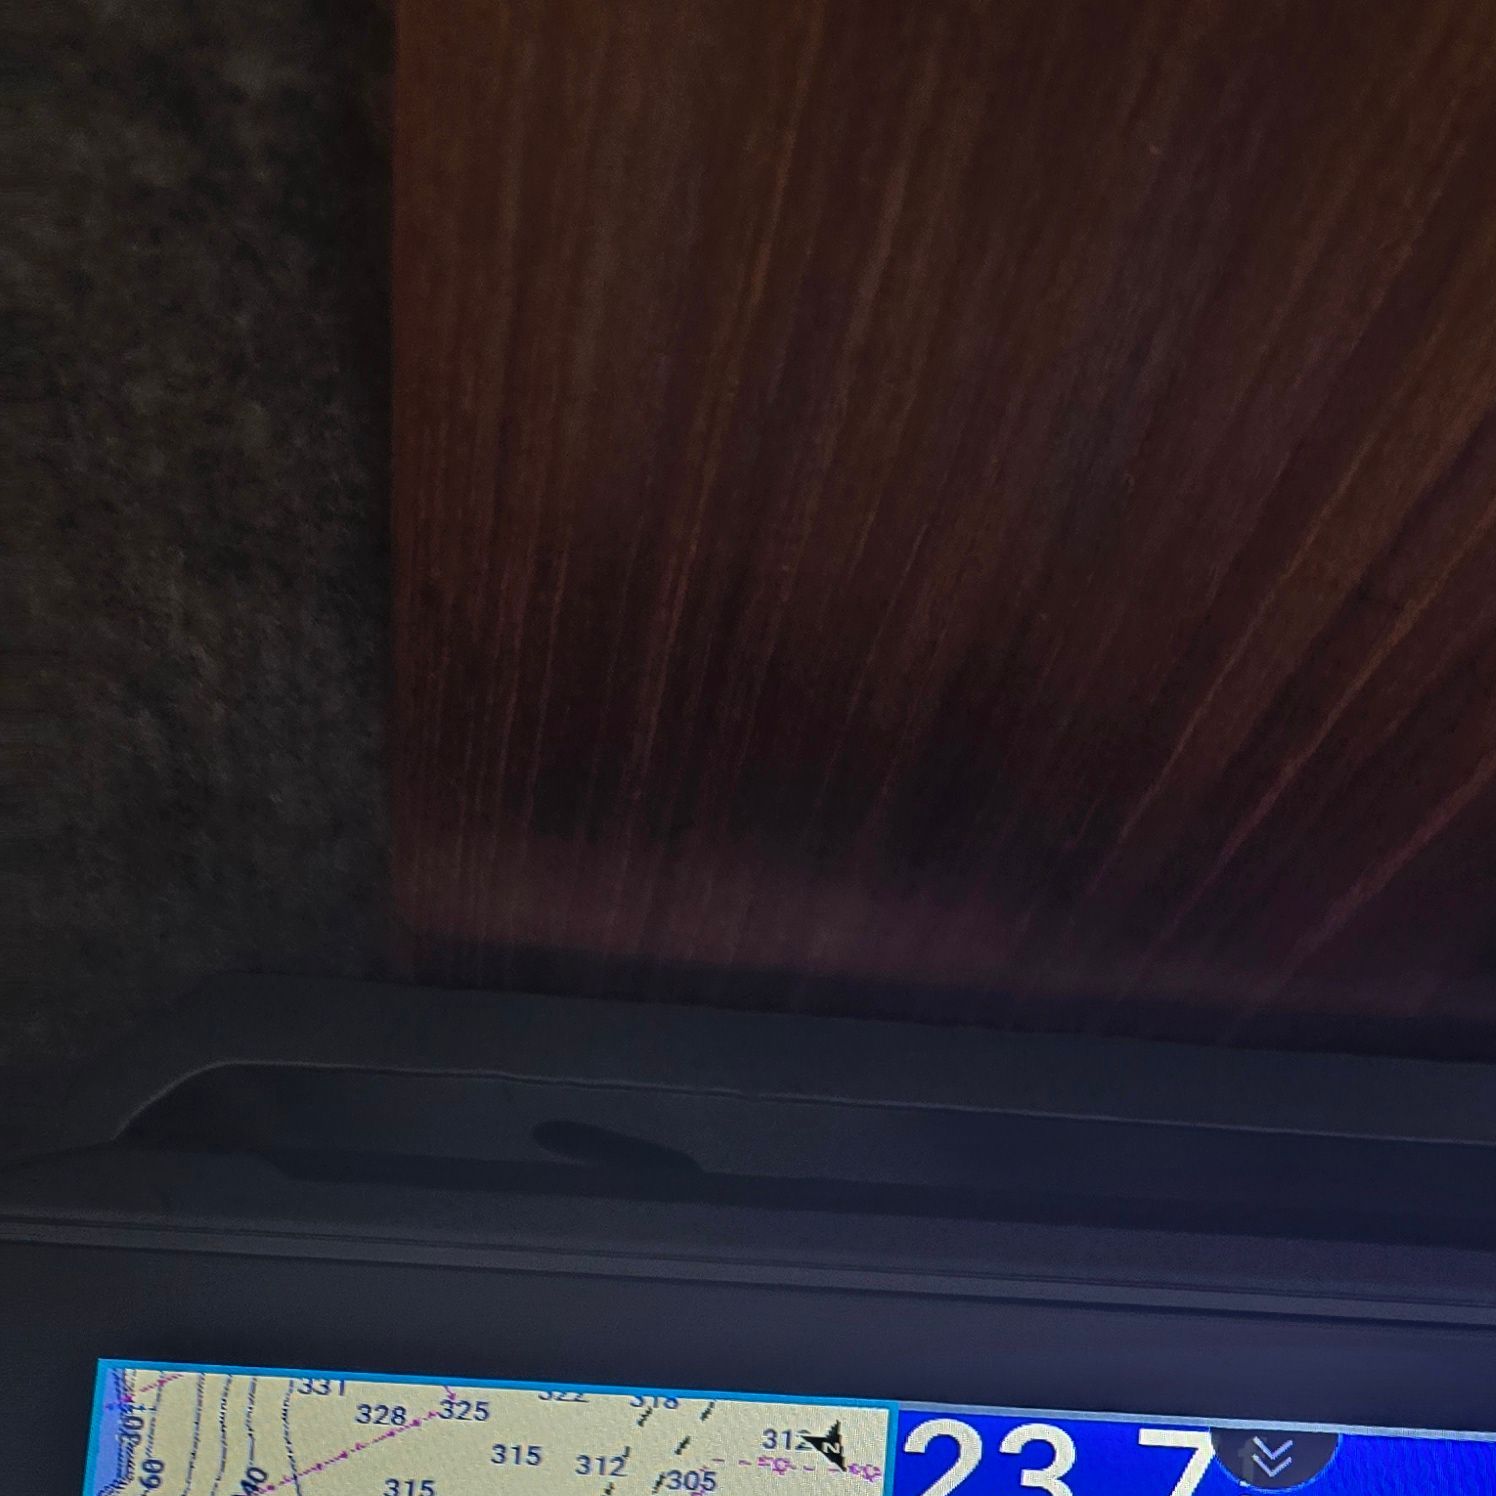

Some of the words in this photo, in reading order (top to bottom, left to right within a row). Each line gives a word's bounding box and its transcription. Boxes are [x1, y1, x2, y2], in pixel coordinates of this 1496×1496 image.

[355, 1404, 406, 1424] 328
[439, 1400, 489, 1421] 325
[490, 1444, 543, 1467] 315
[575, 1455, 627, 1477] 312
[666, 1470, 717, 1492] 305
